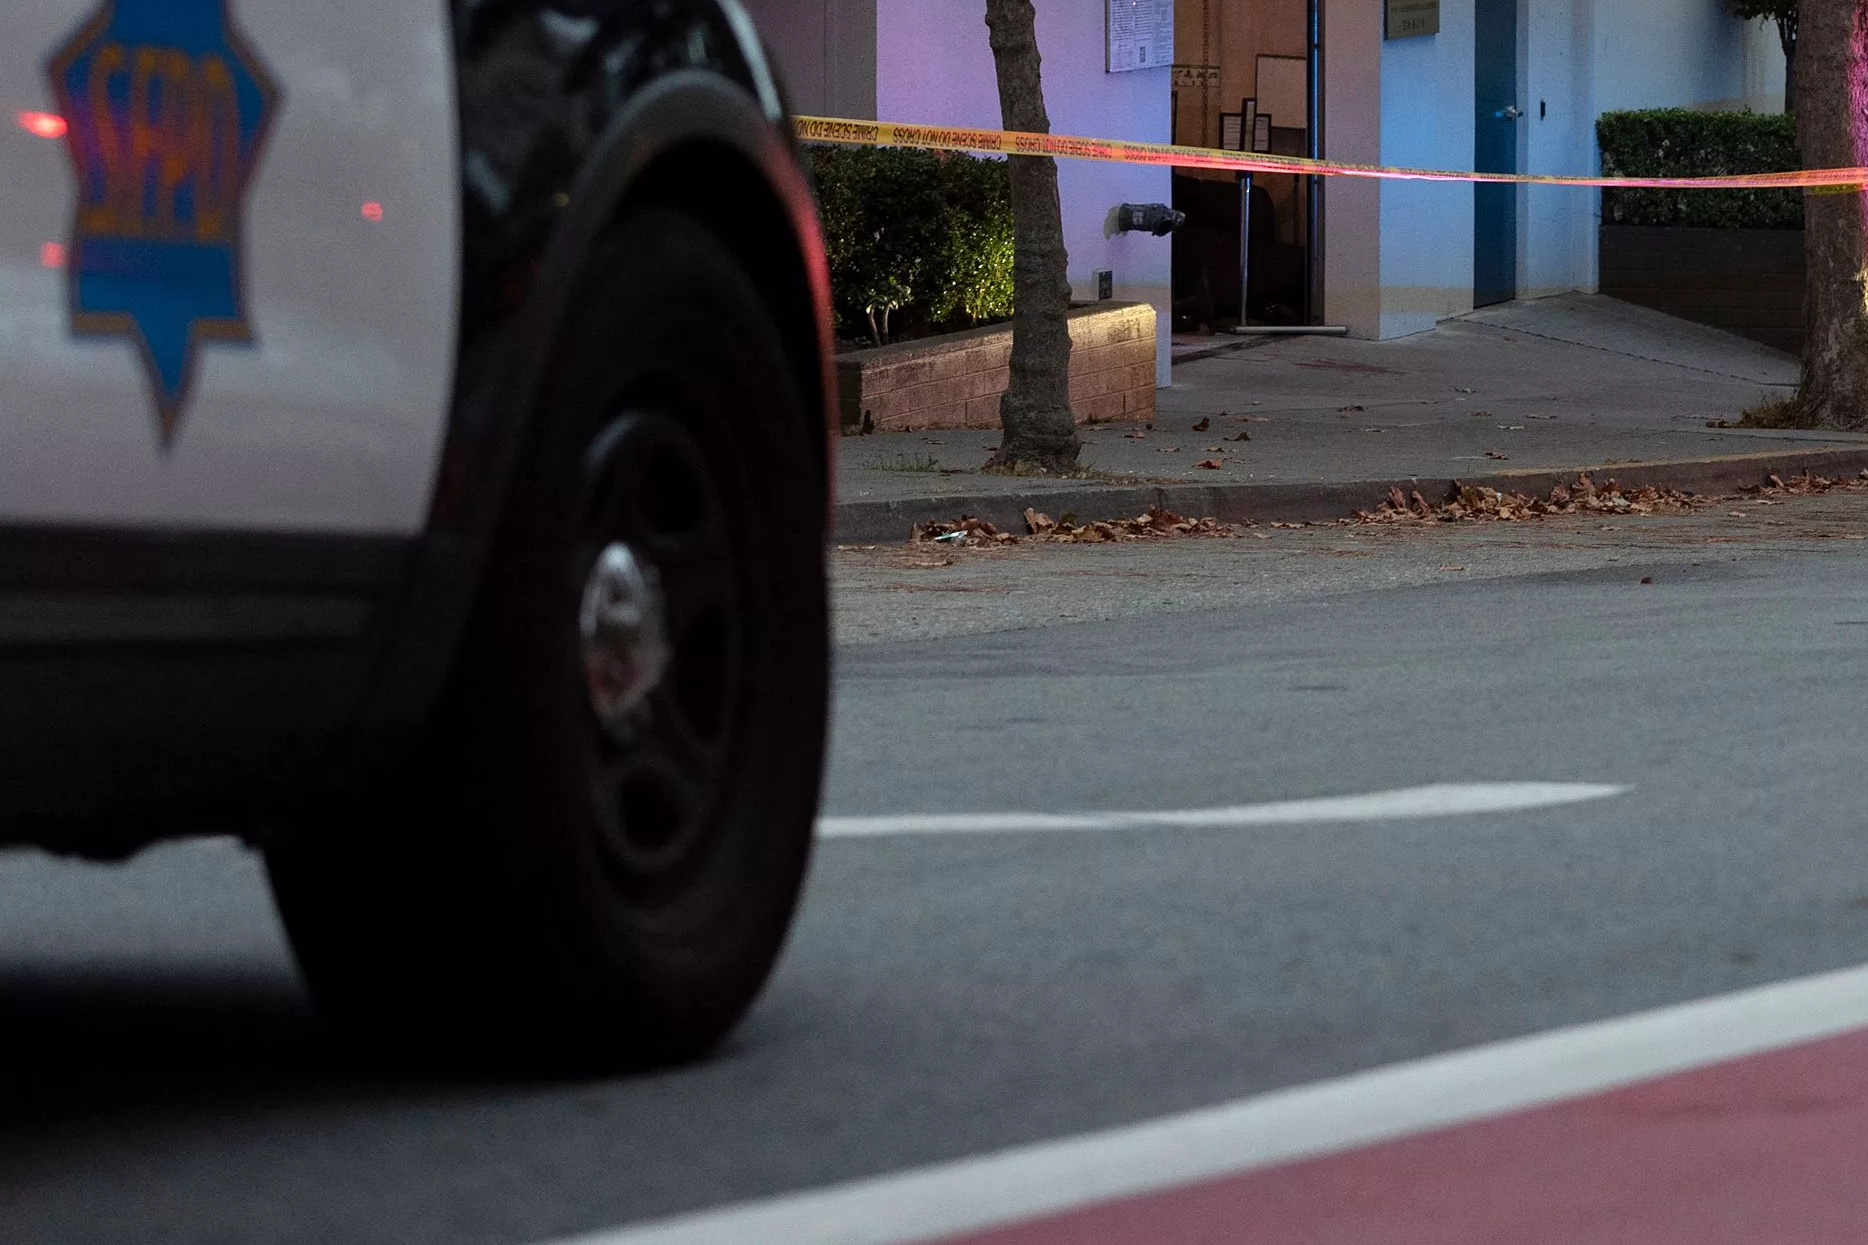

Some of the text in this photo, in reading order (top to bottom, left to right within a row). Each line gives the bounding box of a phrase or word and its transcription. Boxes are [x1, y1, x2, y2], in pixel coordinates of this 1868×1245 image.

[824, 122, 853, 140] SCENE
[853, 124, 879, 142] CRIME
[893, 126, 921, 144] CROSS
[952, 132, 978, 148] SCENE
[978, 135, 1002, 151] CRIME
